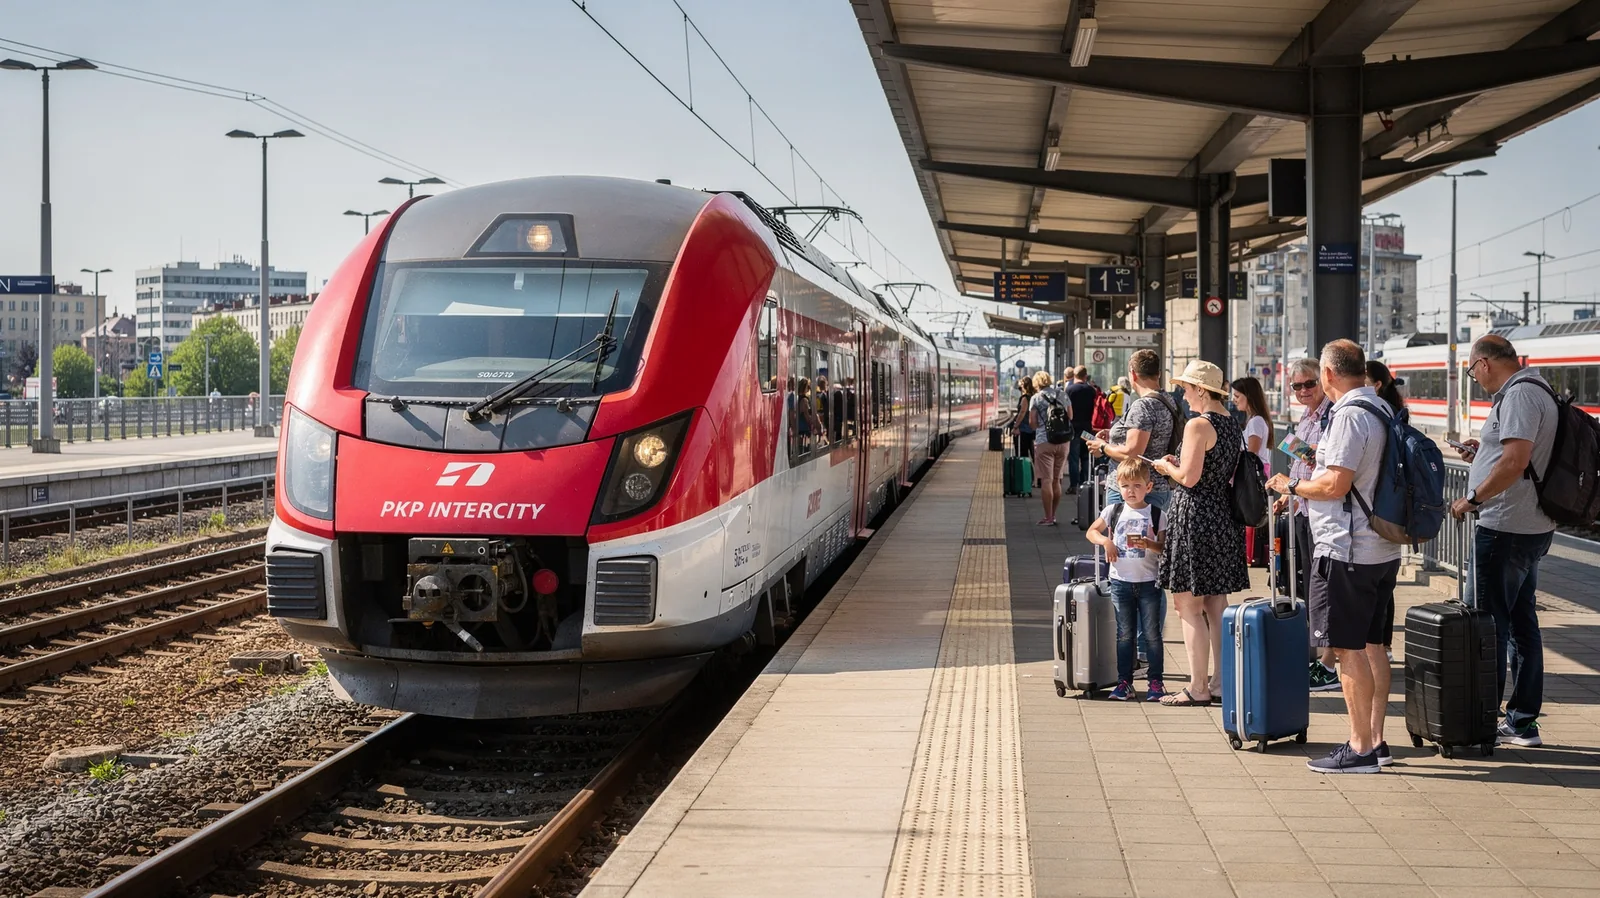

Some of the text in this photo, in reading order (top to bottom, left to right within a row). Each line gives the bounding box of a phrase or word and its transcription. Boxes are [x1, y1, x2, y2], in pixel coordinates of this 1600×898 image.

[1099, 270, 1108, 292] 1
[380, 501, 546, 520] PKP INTERCITY
